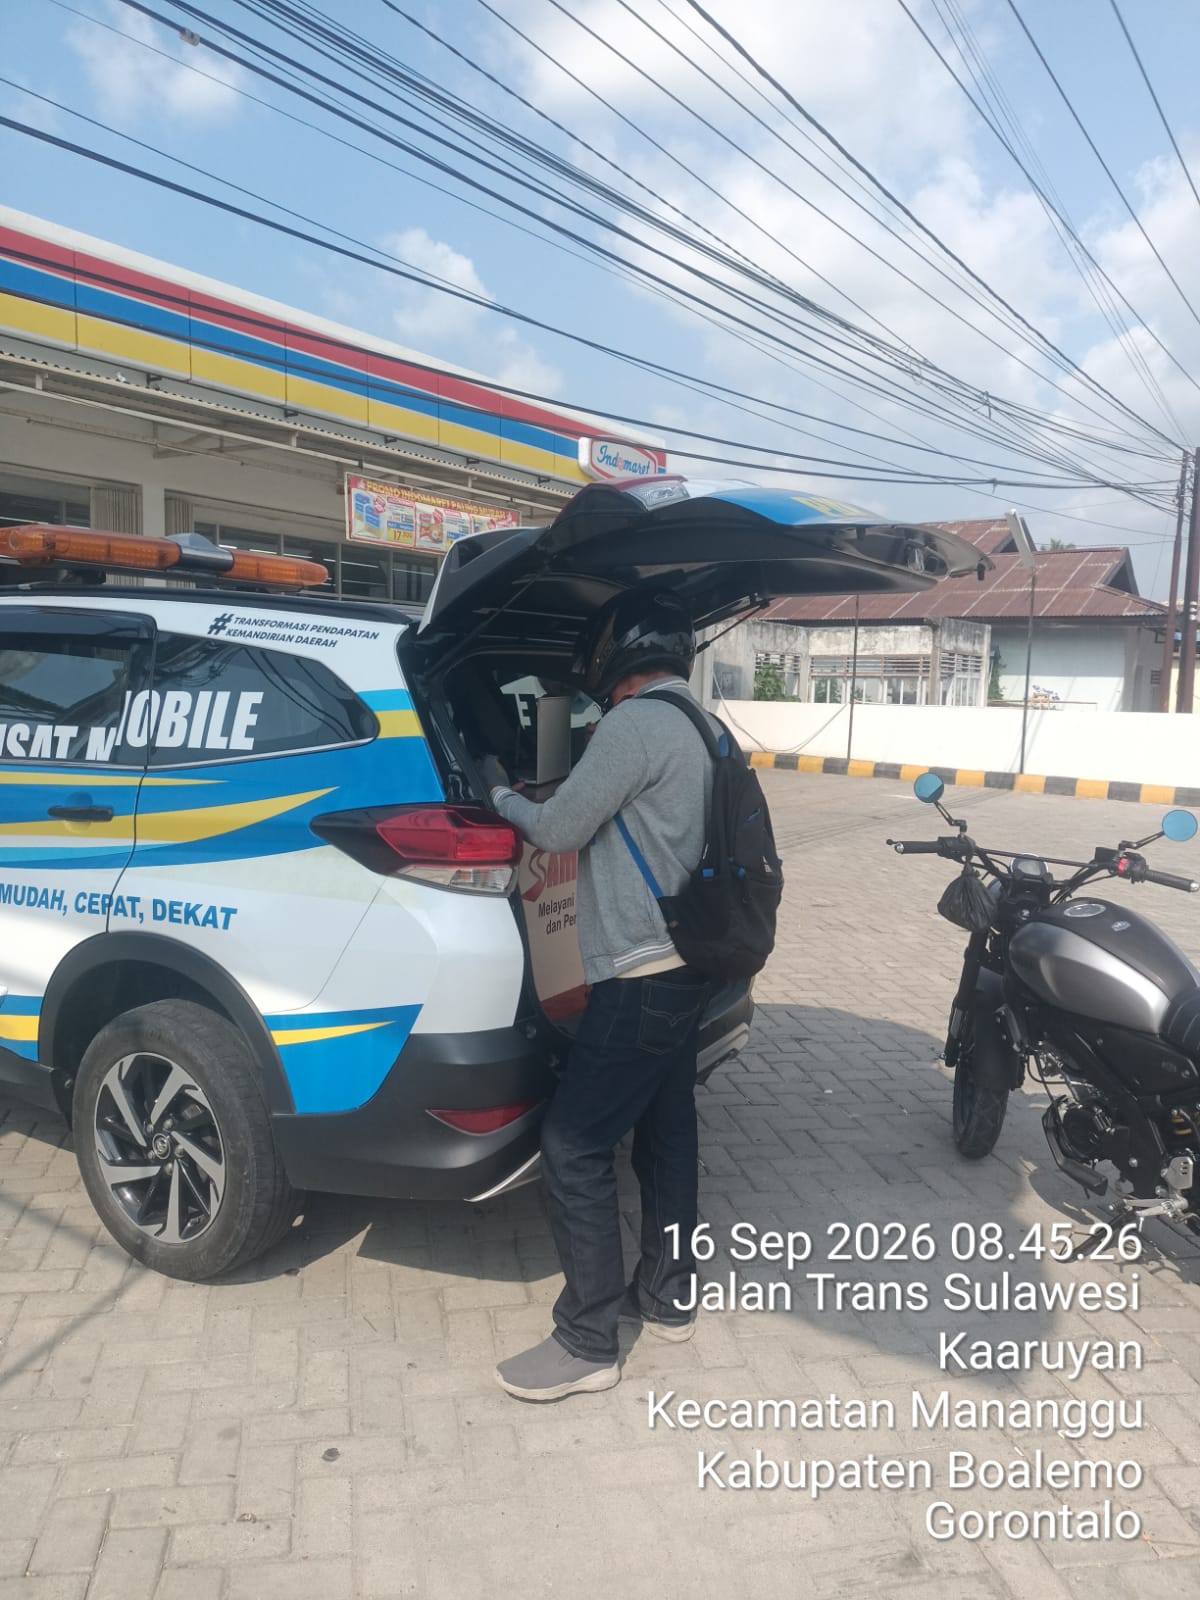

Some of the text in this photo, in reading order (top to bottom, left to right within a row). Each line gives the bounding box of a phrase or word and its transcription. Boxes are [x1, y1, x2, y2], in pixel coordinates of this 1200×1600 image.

[366, 481, 400, 499] PROMO
[226, 628, 338, 648] KEMANDIRIAN DAERAH
[310, 623, 380, 641] PENDAPATAN
[0, 883, 238, 930] MUDAH, CEPAT, DEKAT
[538, 892, 575, 918] Melayani
[545, 919, 562, 935] dan
